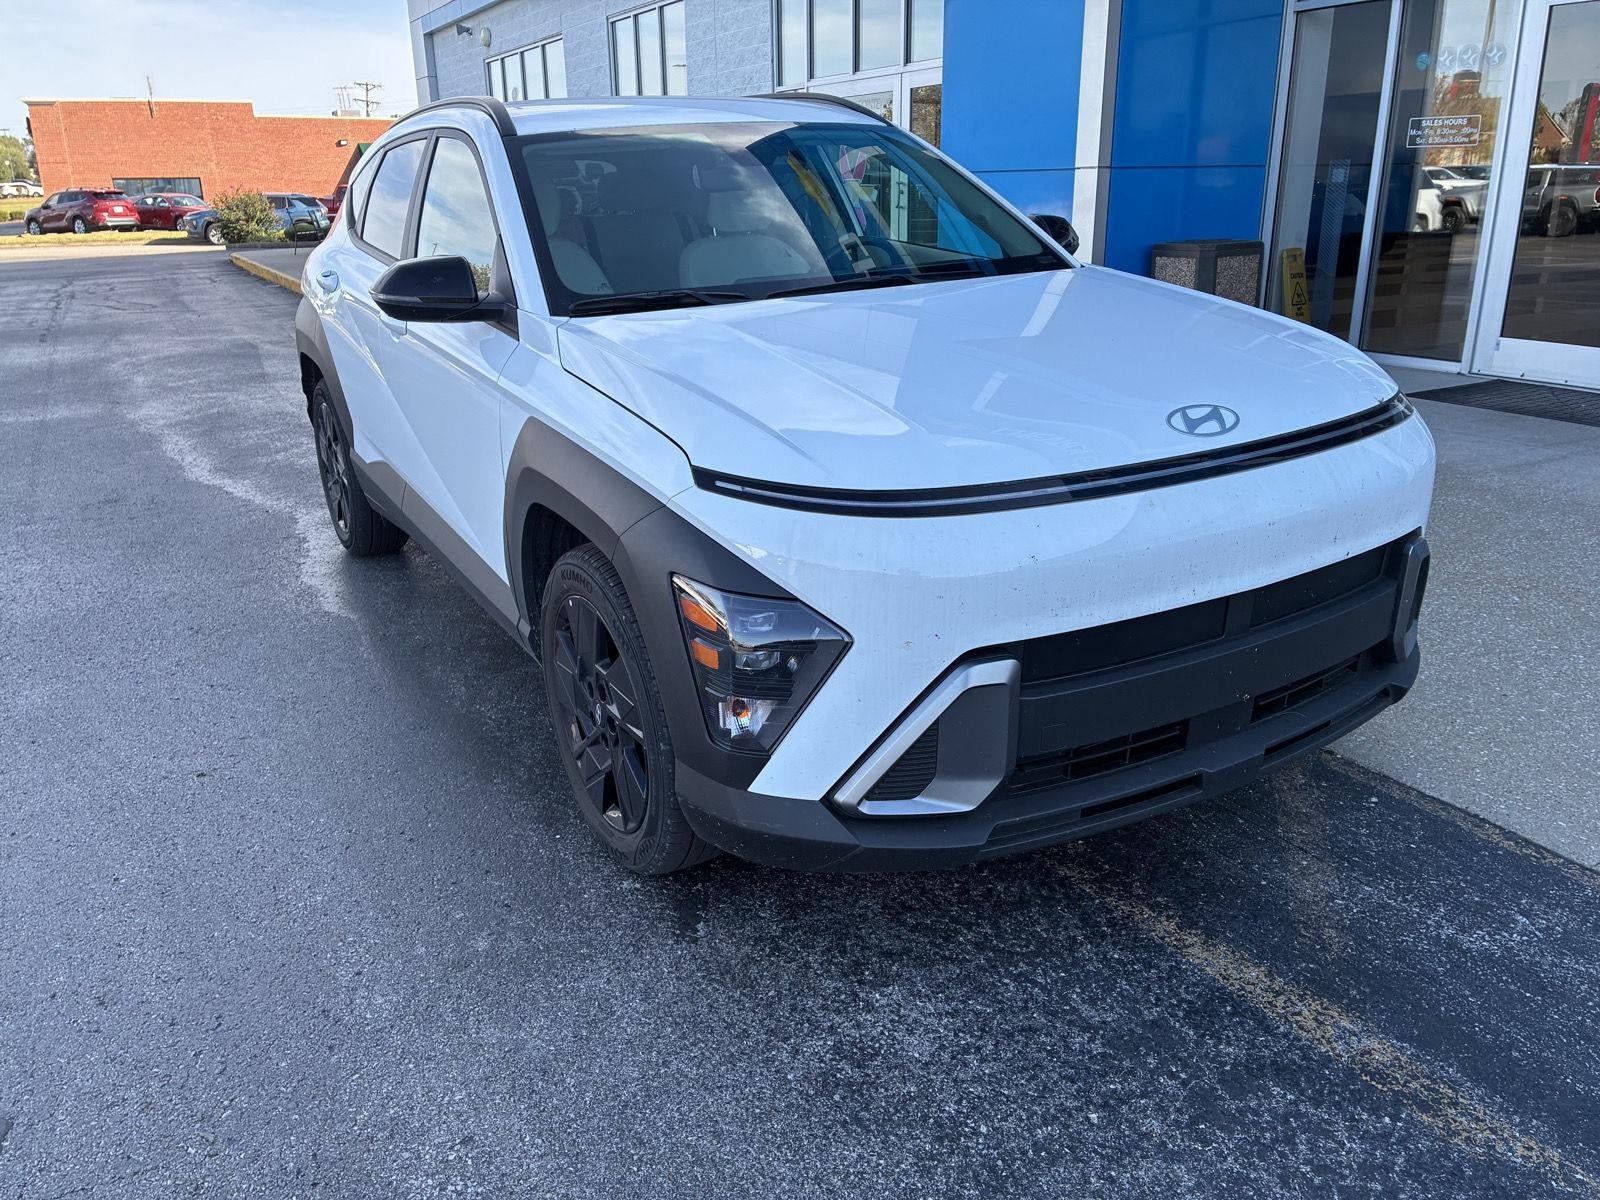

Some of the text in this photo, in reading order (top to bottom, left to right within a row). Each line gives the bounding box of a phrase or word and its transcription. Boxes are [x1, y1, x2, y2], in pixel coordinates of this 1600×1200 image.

[1422, 118, 1468, 127] SALES HOURS
[560, 568, 593, 594] KUMHO
